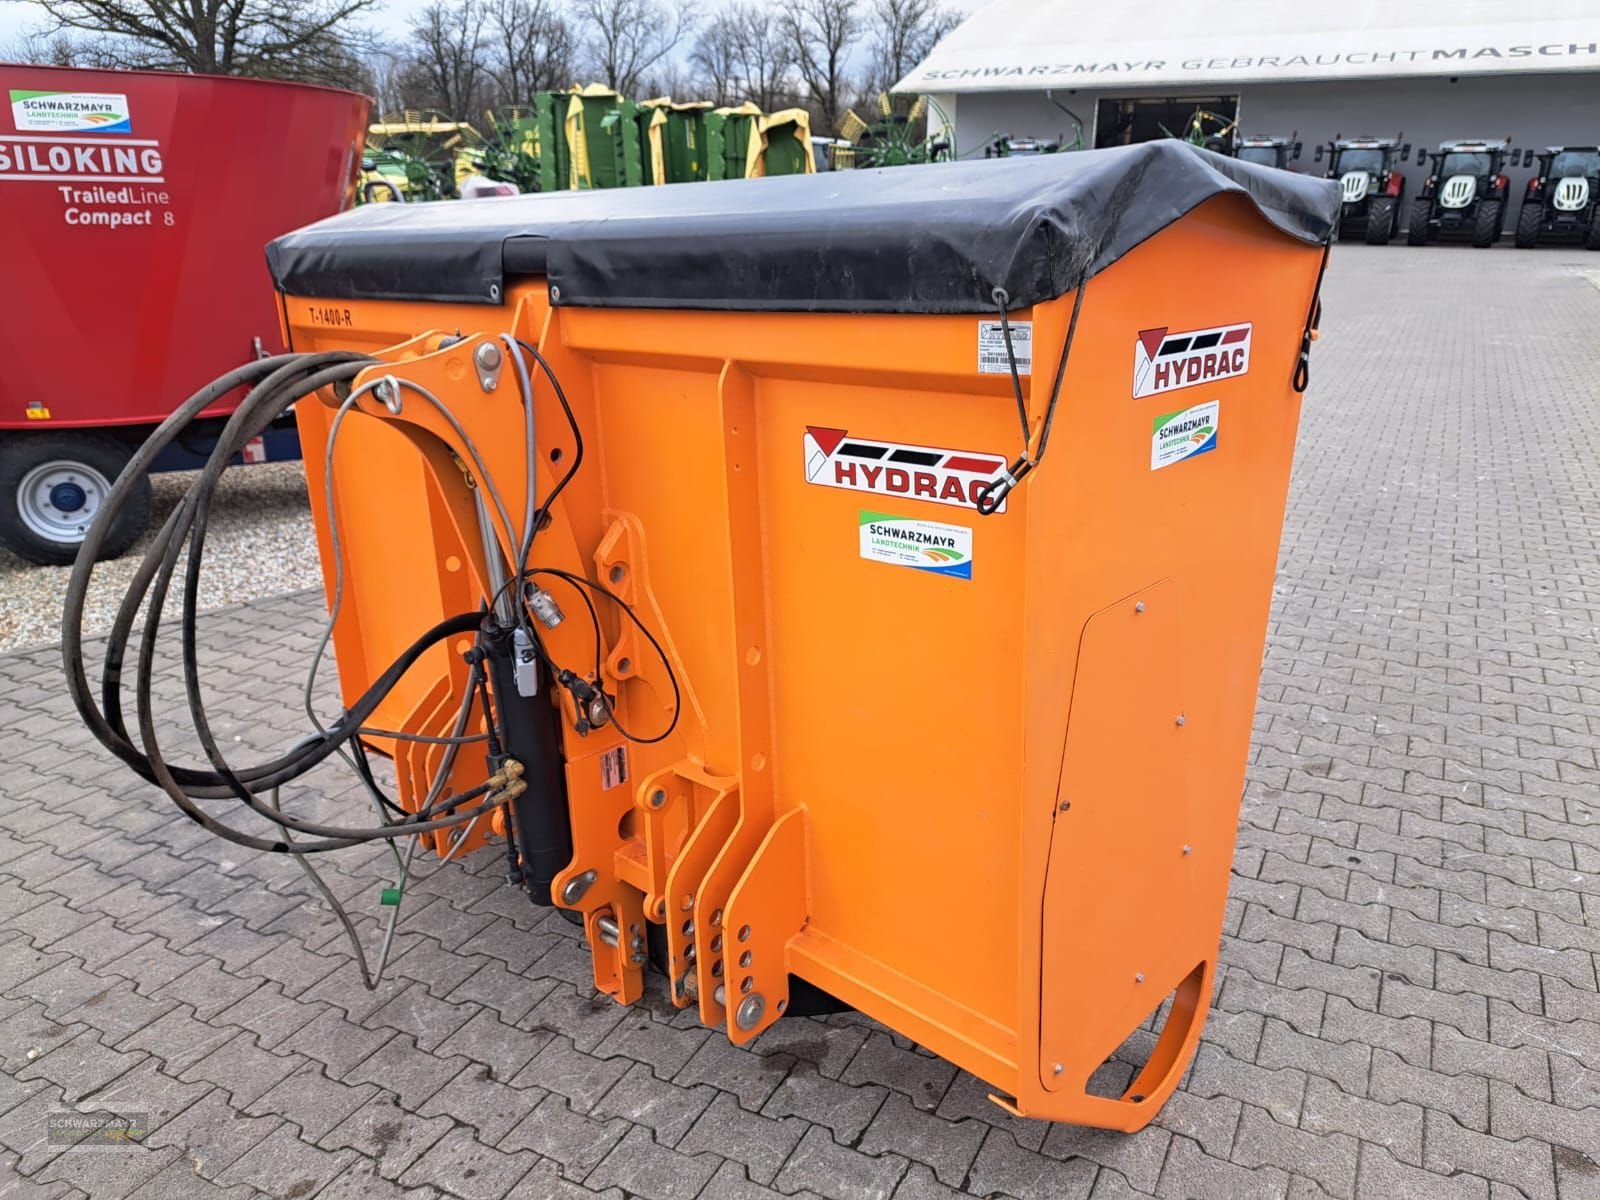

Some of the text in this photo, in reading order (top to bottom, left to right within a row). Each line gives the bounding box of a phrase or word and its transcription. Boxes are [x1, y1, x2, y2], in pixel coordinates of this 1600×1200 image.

[922, 59, 1166, 81] SCHWARZMAYR
[23, 100, 113, 112] SCHWARZMAYR
[58, 186, 169, 205] TrailedLine
[64, 207, 174, 229] Compact 8
[309, 307, 352, 327] T-1400-R
[1153, 347, 1245, 390] HYDRAC
[1159, 415, 1210, 440] SCHWARZMAYR
[834, 460, 997, 507] HYDRAC
[869, 524, 955, 549] SCHWARZMAYR
[871, 537, 920, 553] LANDTECHNIK
